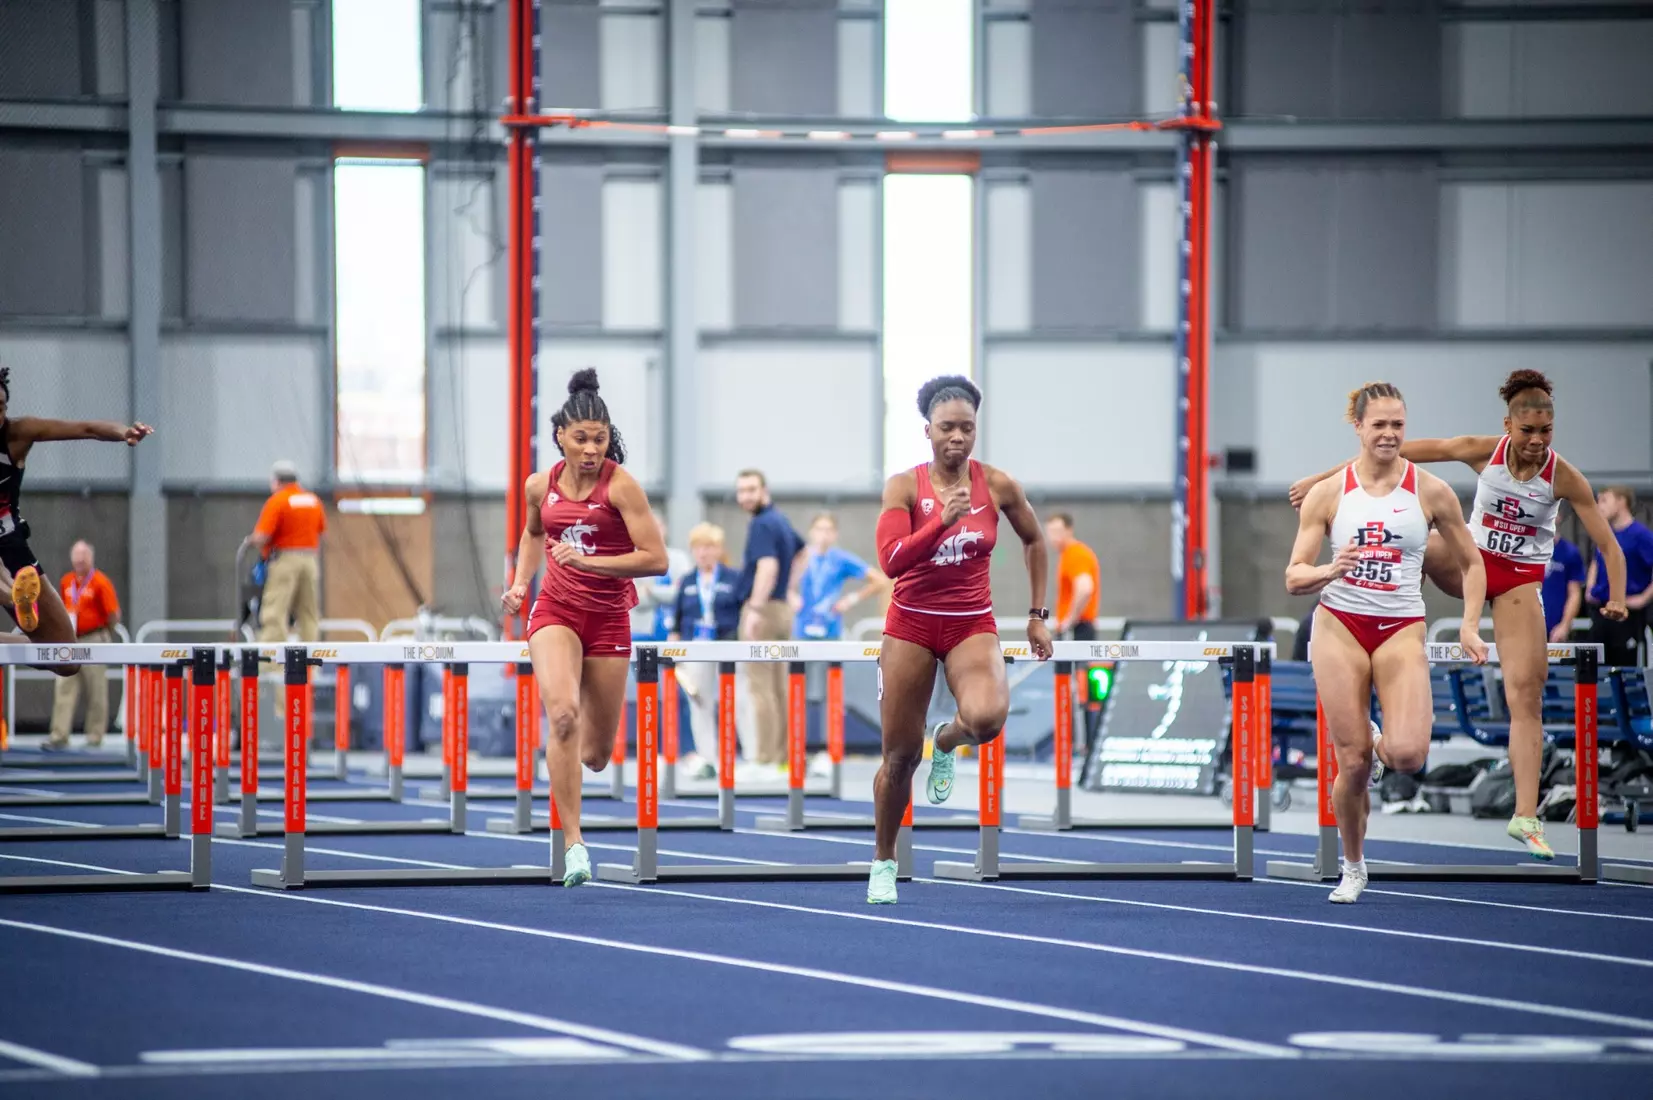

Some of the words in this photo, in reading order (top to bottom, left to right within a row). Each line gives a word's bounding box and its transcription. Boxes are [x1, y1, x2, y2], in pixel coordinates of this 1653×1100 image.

[1494, 520, 1508, 530] WSU
[1510, 524, 1526, 532] OPEN
[1487, 530, 1526, 556] 662
[1375, 550, 1393, 560] OPEN
[37, 648, 50, 660] THE
[53, 646, 93, 661] PODIUM
[161, 650, 188, 658] GILL
[312, 649, 338, 658] GILL
[403, 647, 416, 659] THE
[418, 645, 454, 660] PODIUM
[662, 648, 687, 656] GILL
[750, 646, 762, 658] THE
[764, 644, 799, 659] PODIUM
[863, 648, 881, 656] GIL
[1004, 647, 1028, 656] GILL
[1090, 645, 1102, 658] THE
[1105, 644, 1139, 658] PODIUM
[1203, 647, 1228, 656] GILL
[1430, 646, 1443, 658] THE
[1548, 648, 1571, 658] GILL
[200, 698, 208, 820] SPOKANE
[292, 698, 300, 820] SPOKANE
[1584, 698, 1592, 816] SPOKANE
